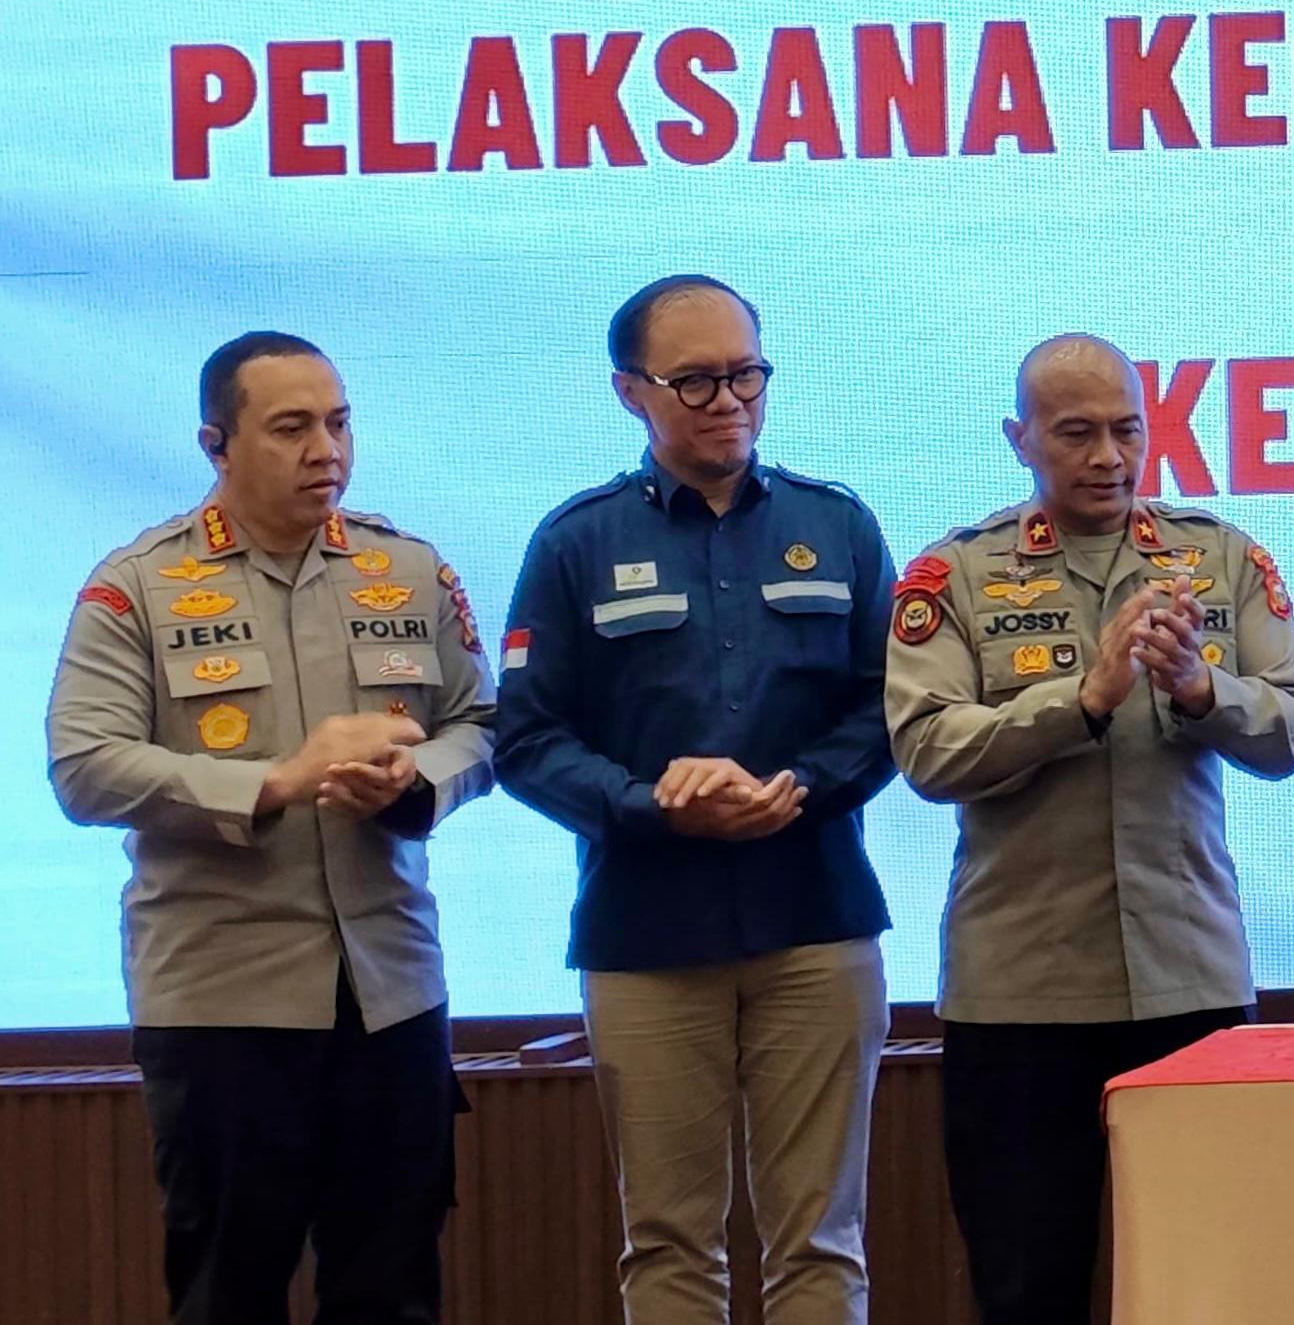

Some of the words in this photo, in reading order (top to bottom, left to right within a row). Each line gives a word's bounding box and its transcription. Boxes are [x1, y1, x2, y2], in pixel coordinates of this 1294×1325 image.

[172, 22, 1053, 179] PELAKSANA
[167, 620, 252, 651] JEKI
[350, 619, 429, 640] POLRI
[985, 610, 1071, 636] JOSSY
